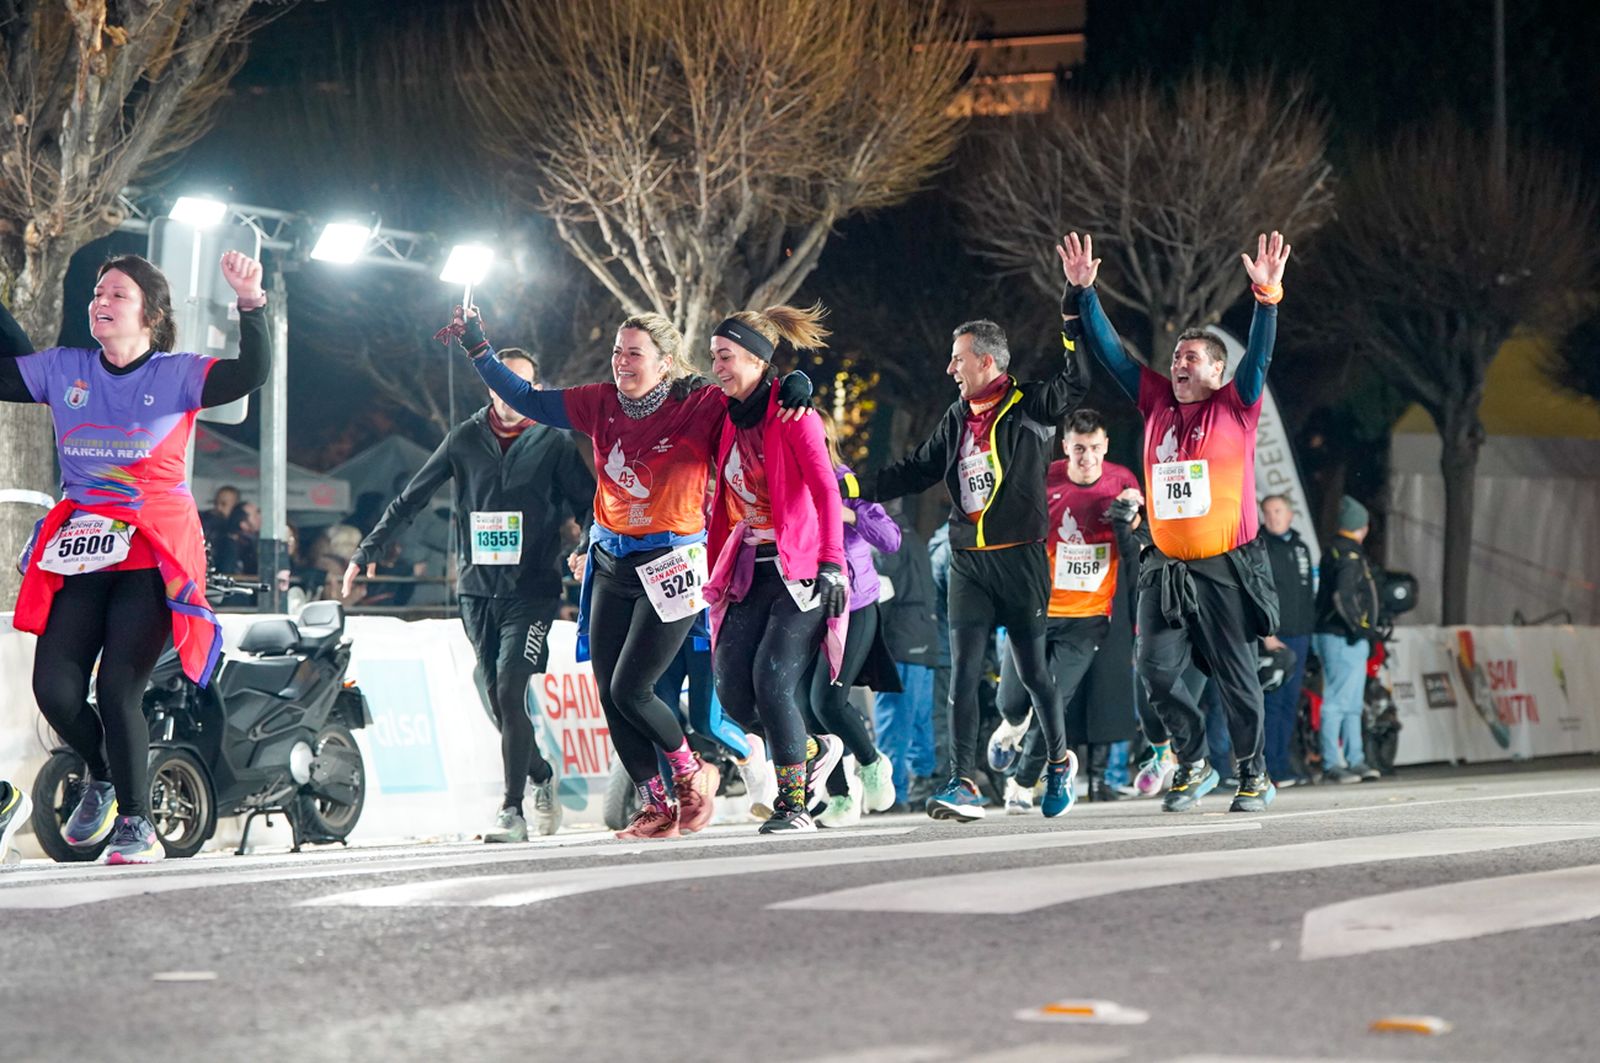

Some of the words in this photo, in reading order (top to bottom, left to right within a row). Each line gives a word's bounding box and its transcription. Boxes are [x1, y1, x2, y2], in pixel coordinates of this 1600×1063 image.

[63, 446, 115, 458] MANCHA
[117, 449, 153, 459] REAL
[618, 470, 636, 489] 43
[968, 471, 995, 493] 659
[1165, 481, 1193, 500] 784
[58, 534, 115, 558] 5600
[477, 530, 519, 547] 13555
[654, 558, 675, 574] NOCHE
[1066, 560, 1101, 576] 7658
[650, 572, 666, 584] SAN
[544, 673, 601, 720] SAN
[373, 708, 433, 748] alsa
